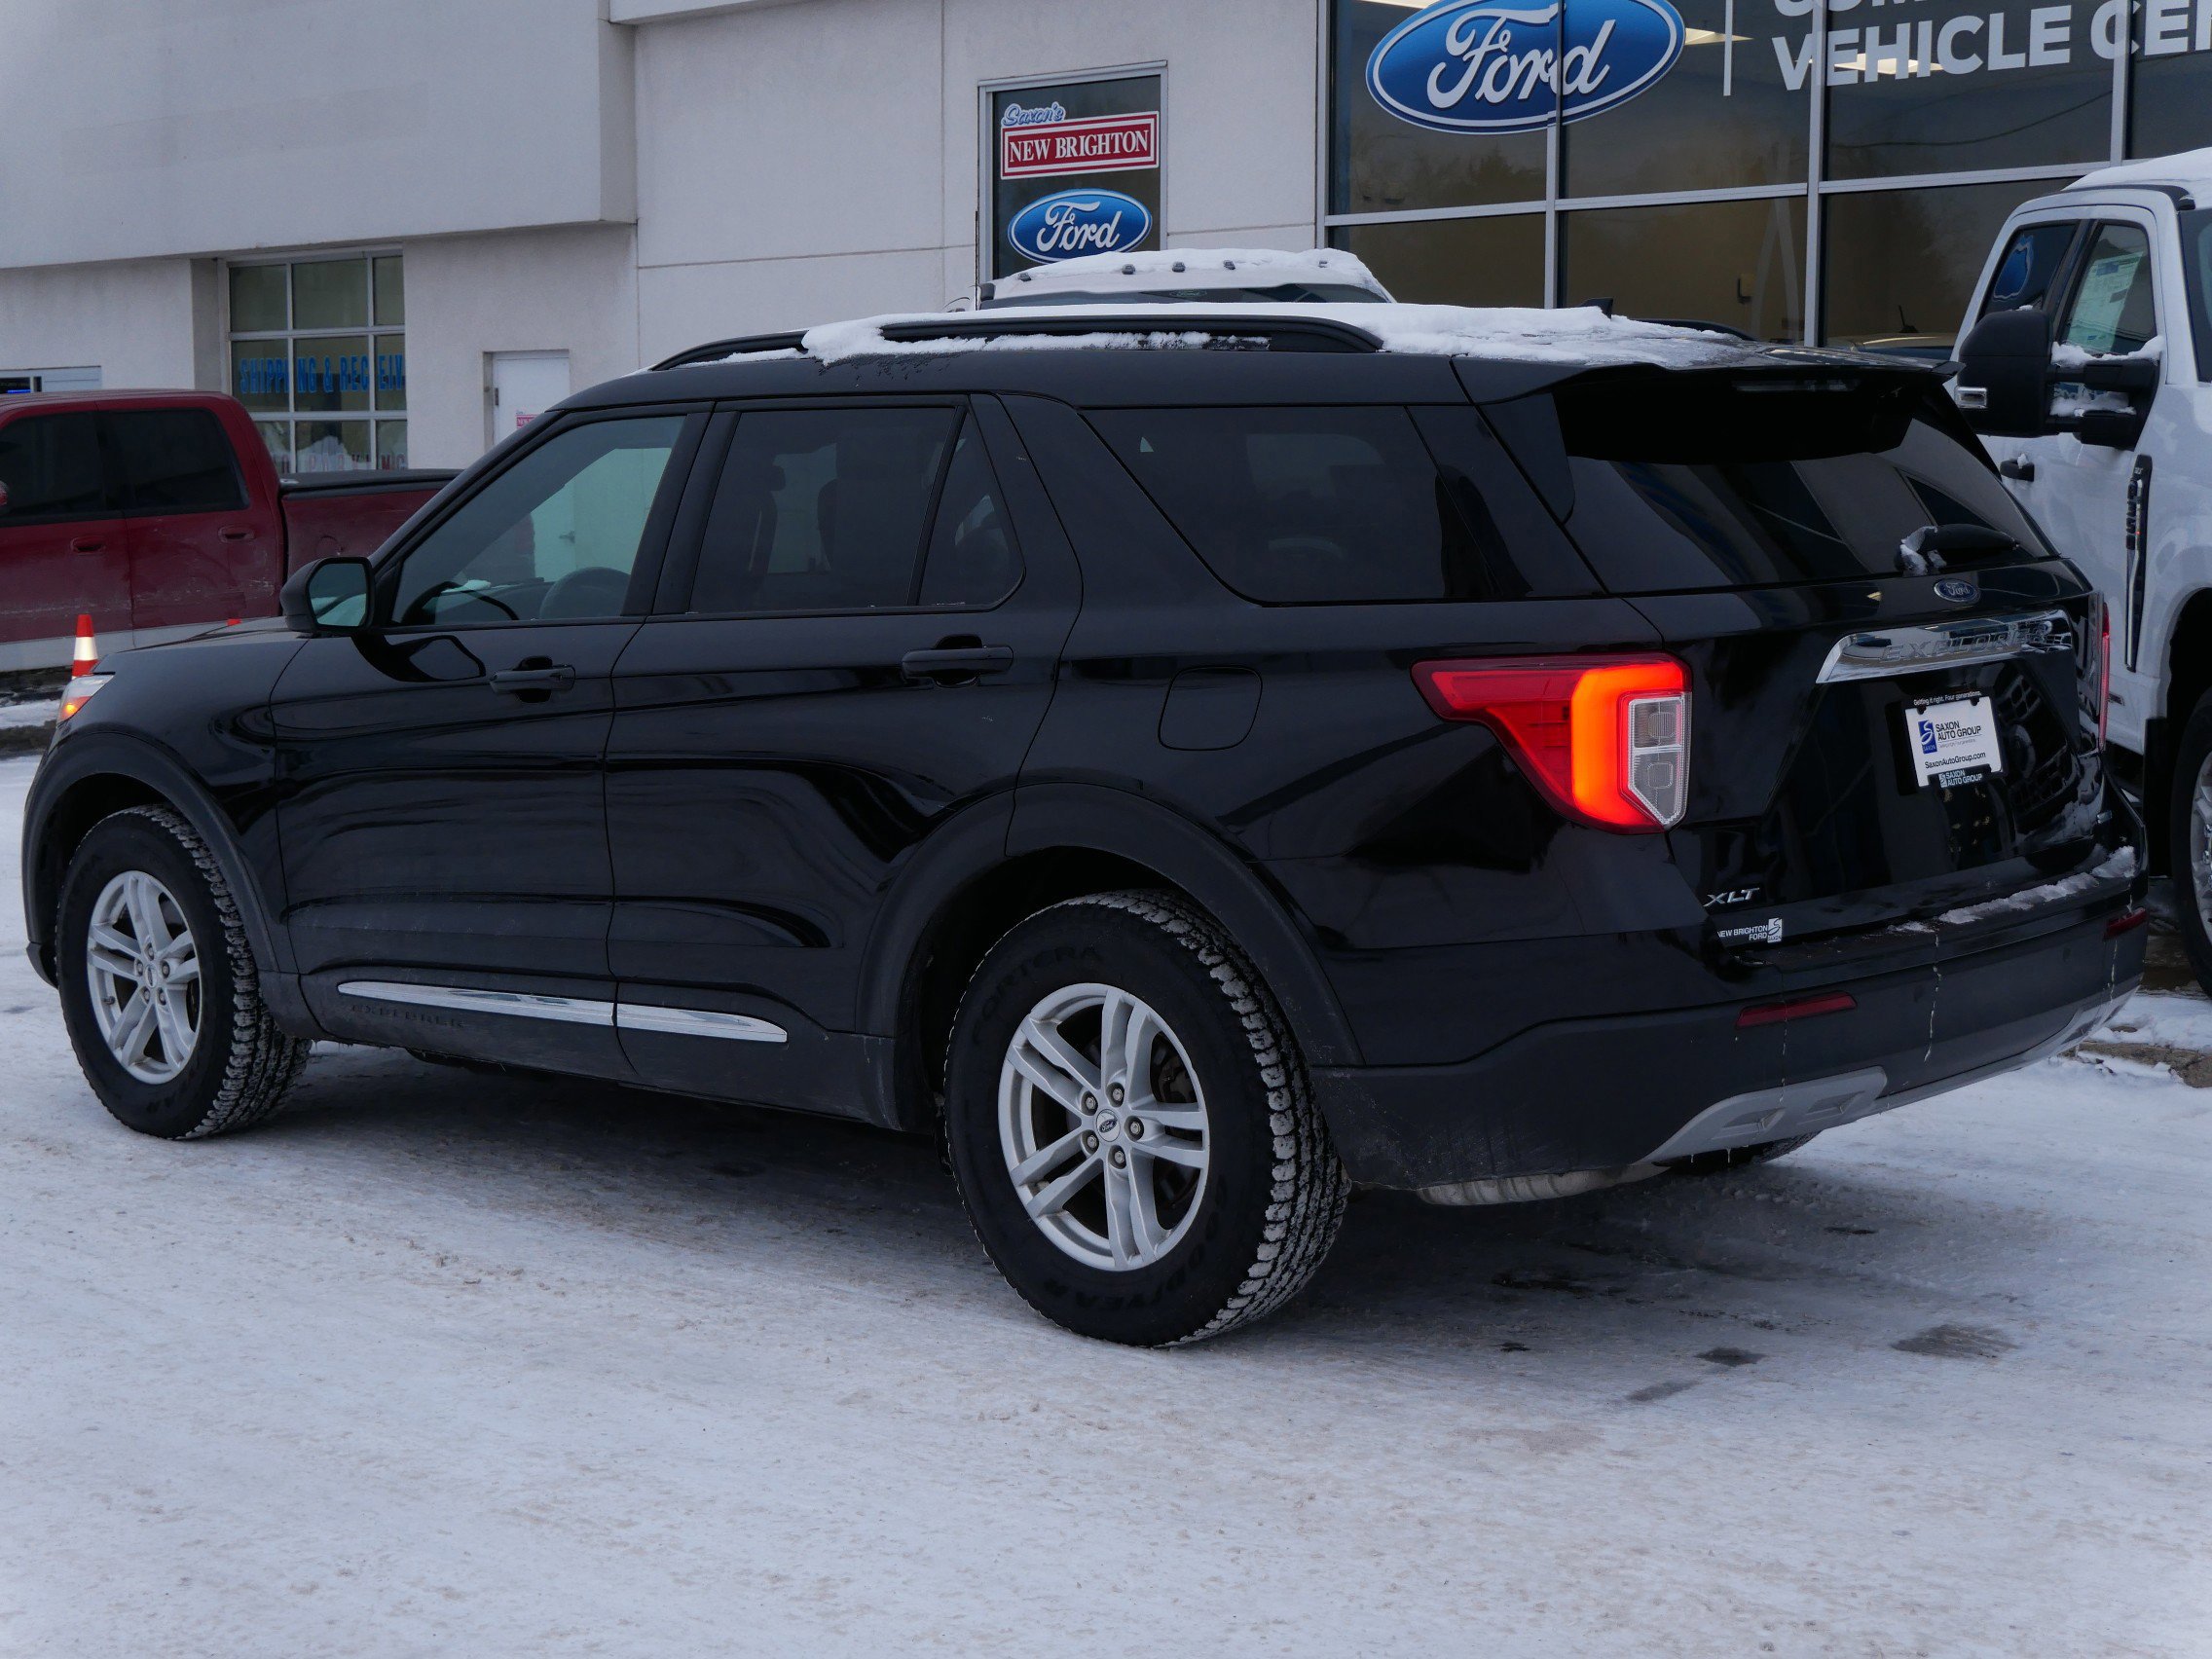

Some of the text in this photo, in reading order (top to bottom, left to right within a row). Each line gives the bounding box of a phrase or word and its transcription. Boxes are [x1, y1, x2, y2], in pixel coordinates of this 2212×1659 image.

[1426, 3, 1616, 108] Ford
[1771, 5, 2072, 91] VEHICLE
[1001, 101, 1065, 127] Saxon's
[1009, 129, 1150, 163] NEW BRIGHTON
[1037, 201, 1124, 252] Ford
[240, 355, 317, 394] SHIPPING
[1936, 720, 1960, 732] SAXON
[1937, 725, 1981, 741] AUTO GROUP
[1924, 752, 1986, 768] SaxonAutoGroup.com
[1945, 769, 1966, 780] SAXON
[1947, 773, 1983, 786] AUTO GROUP
[1703, 887, 1760, 907] XLT
[1733, 925, 1768, 937] BRIGHTON
[1749, 932, 1768, 941] FORD
